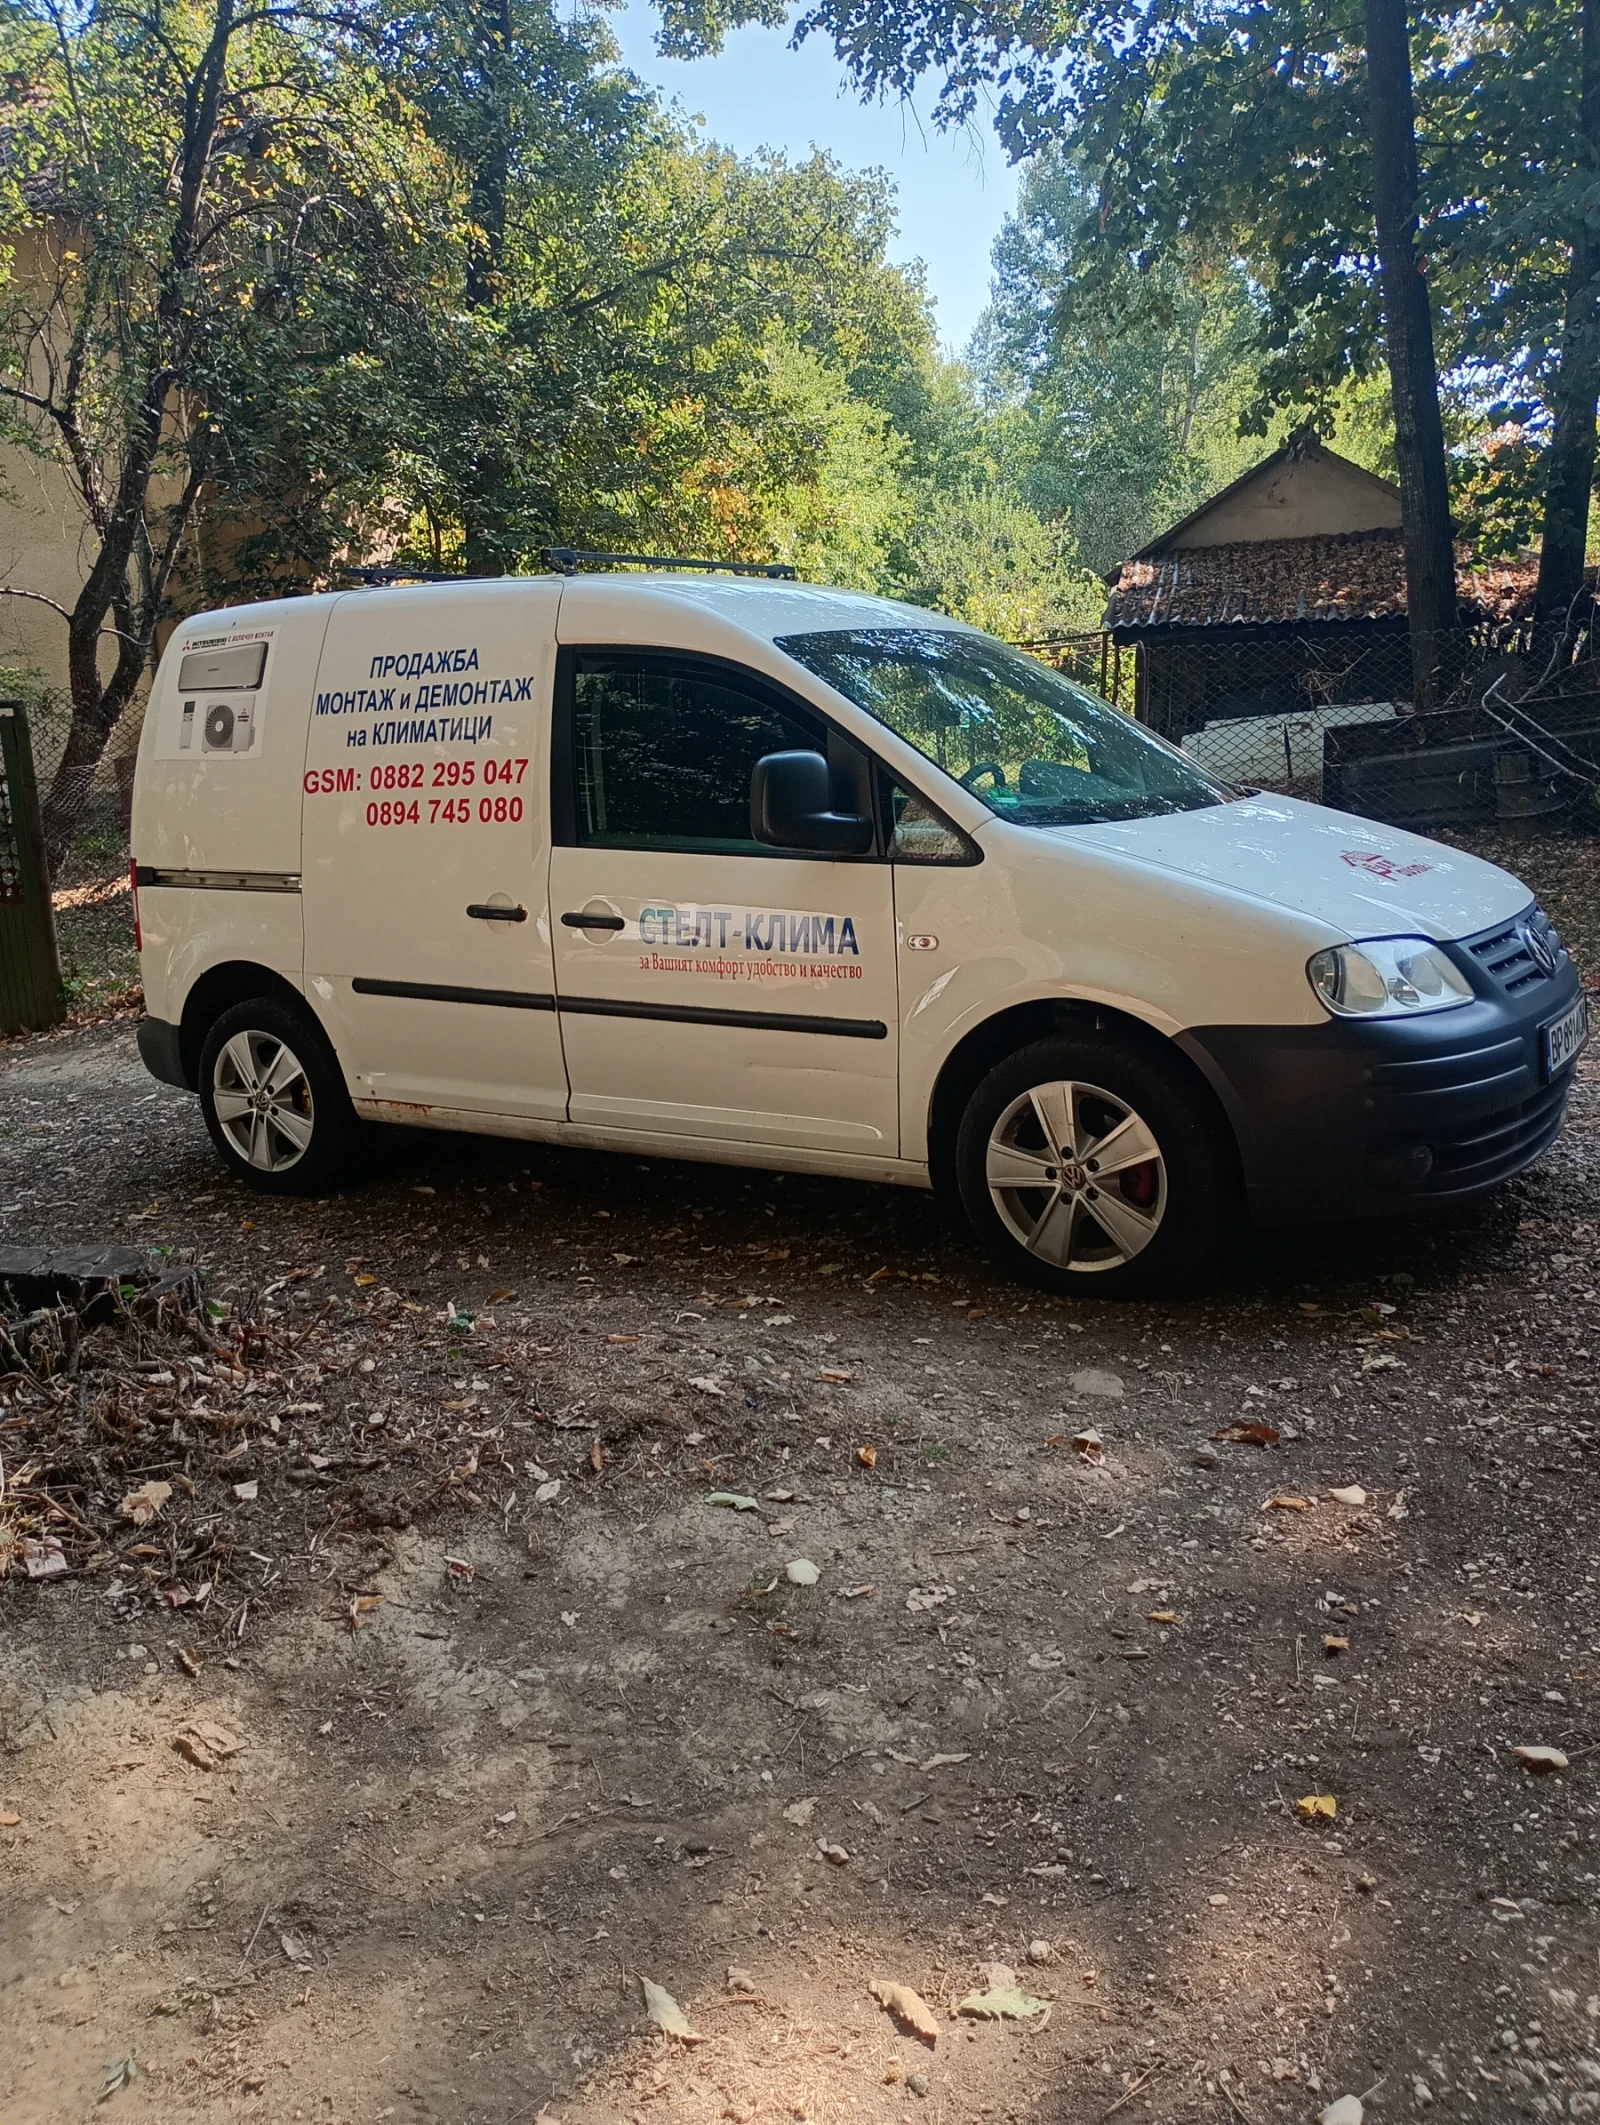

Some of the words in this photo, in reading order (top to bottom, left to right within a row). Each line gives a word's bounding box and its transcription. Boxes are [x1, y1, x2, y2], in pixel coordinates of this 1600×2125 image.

[369, 648, 480, 680] ПРОДАЖБА
[316, 687, 396, 715] МОНТАЖ
[400, 692, 411, 710] и
[414, 676, 534, 713] ДЕМОНТАЖ
[347, 729, 367, 747] на
[372, 715, 492, 745] КЛИМАТИЦИ
[303, 767, 362, 794] GSM:
[370, 763, 425, 790] 0882
[431, 761, 476, 787] 295
[483, 758, 529, 785] 047
[366, 800, 420, 826] 0894
[428, 798, 471, 824] 745
[479, 796, 523, 823] 080
[639, 908, 859, 954] СТЕЛТ-КЛИМА
[639, 956, 650, 970] за
[652, 952, 693, 972] Вашият
[696, 955, 744, 980] комфорт
[747, 957, 797, 980] удобство
[799, 964, 807, 977] и
[810, 964, 862, 979] качество
